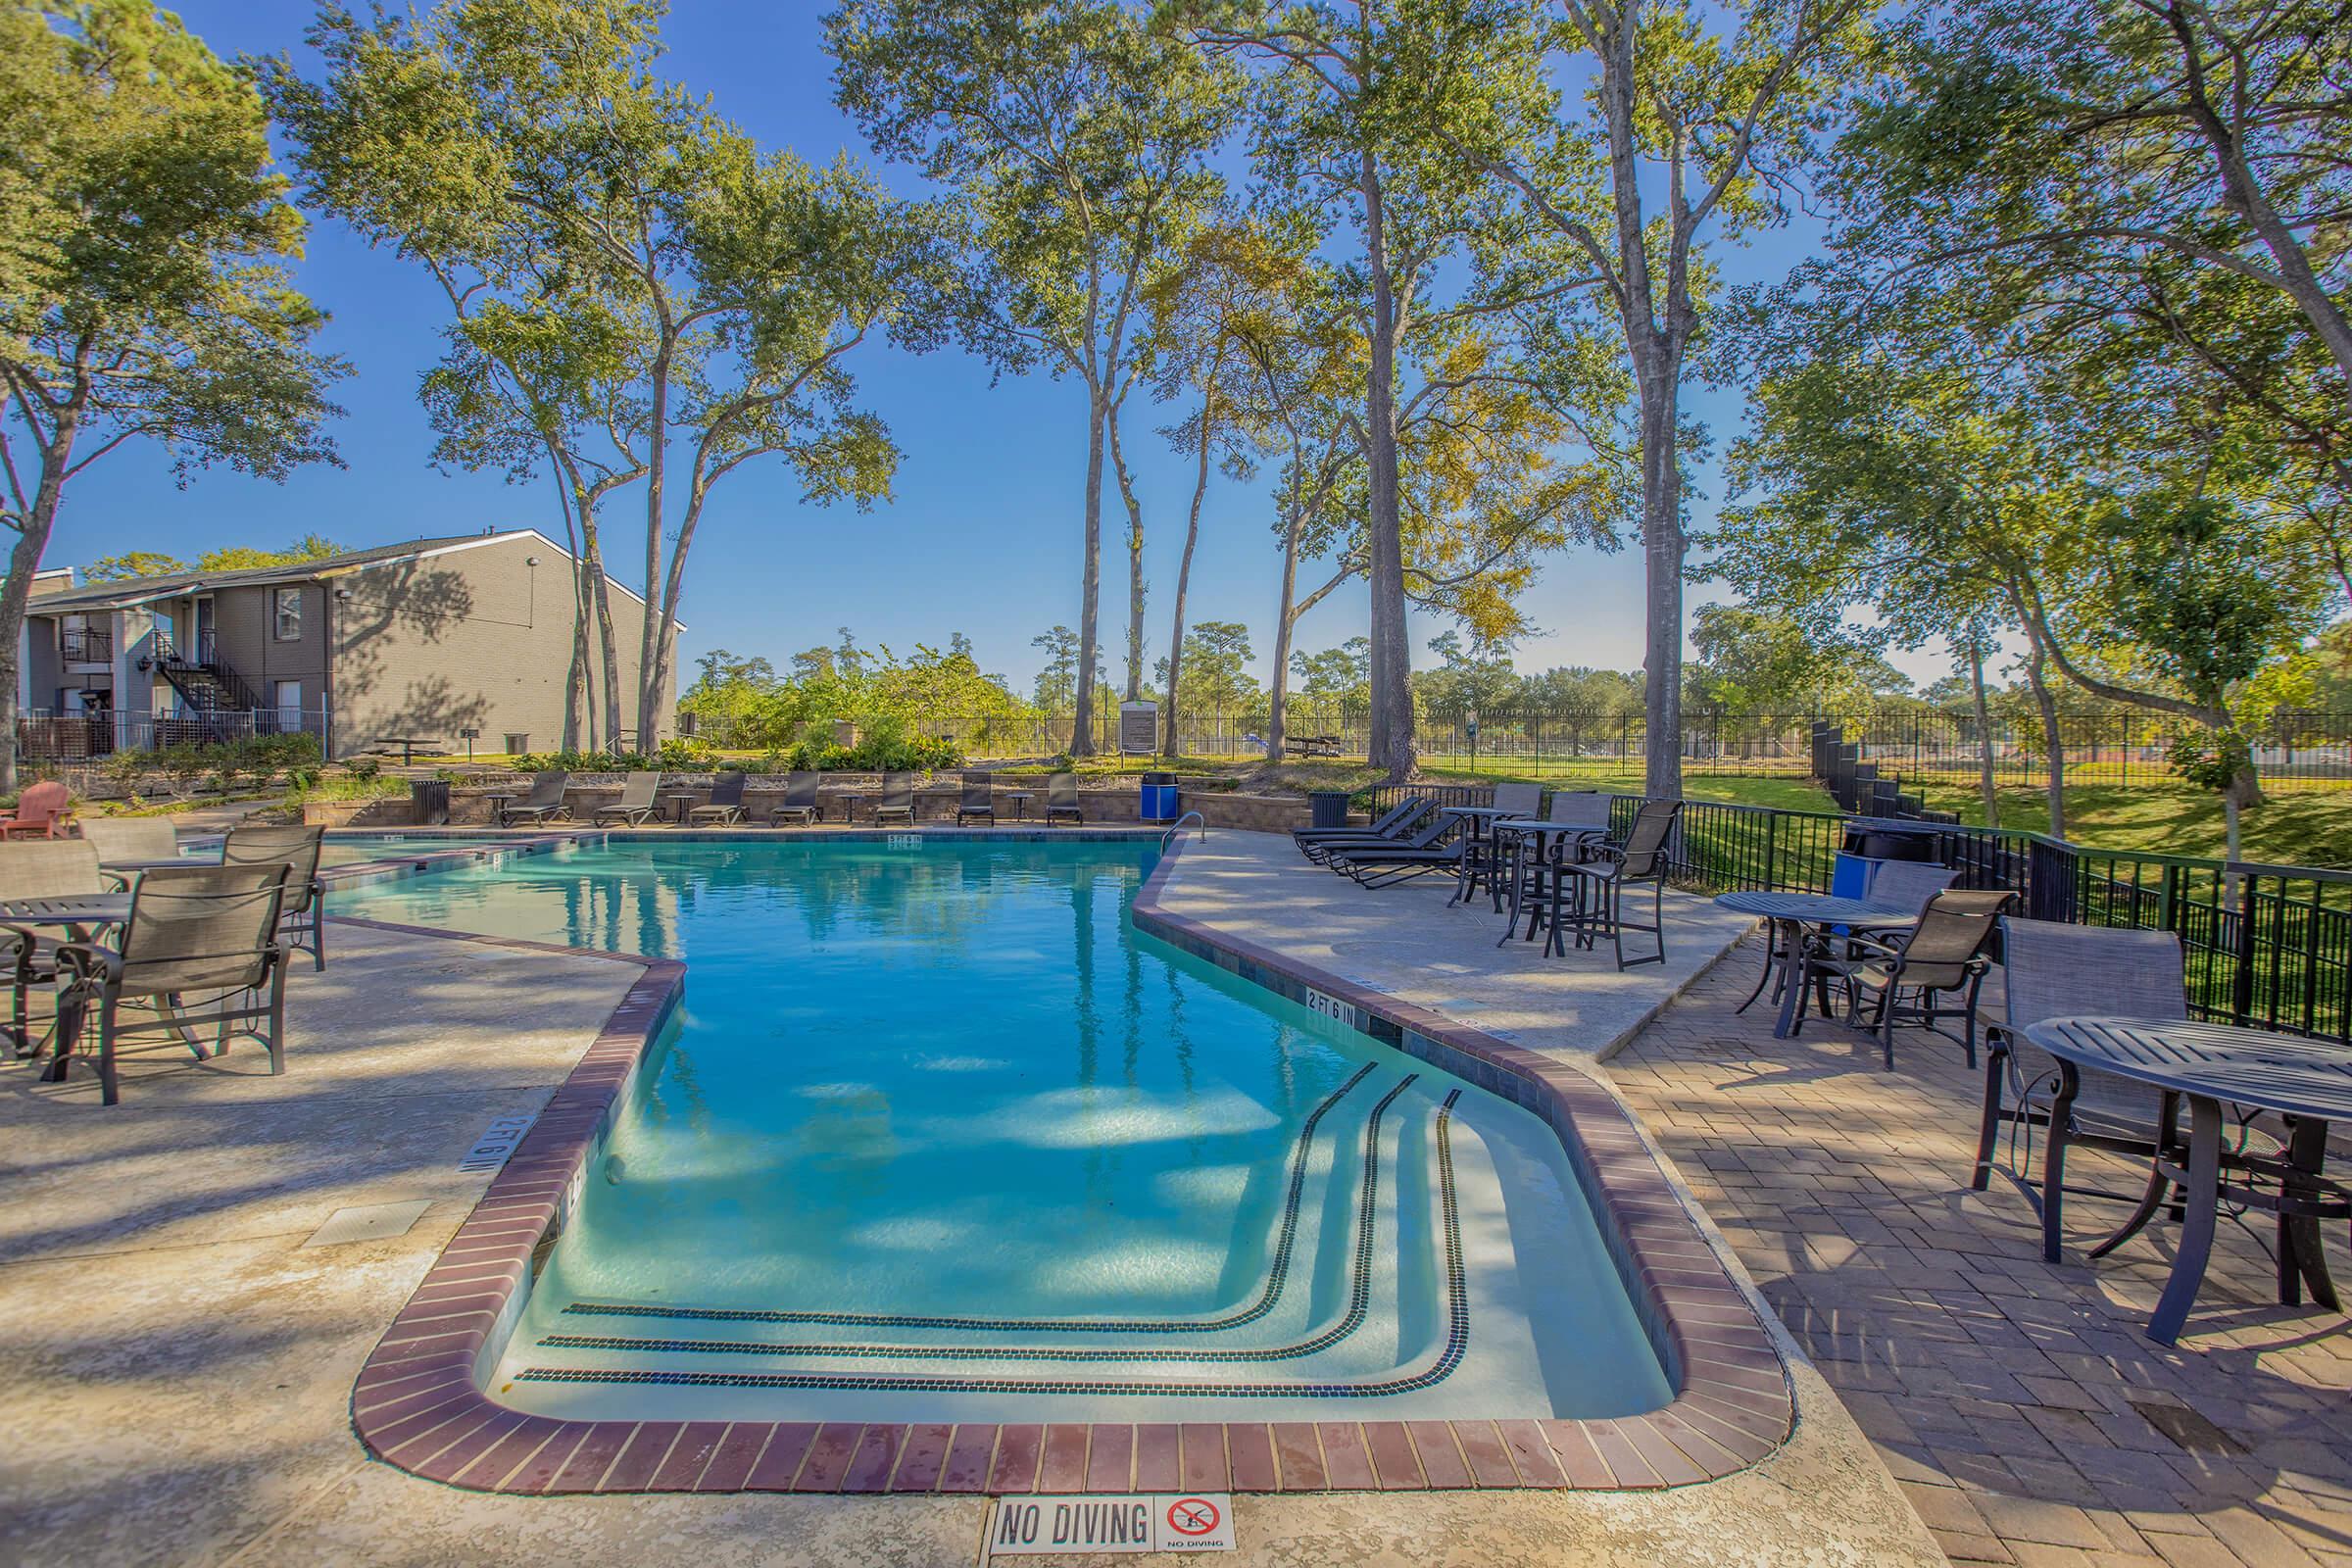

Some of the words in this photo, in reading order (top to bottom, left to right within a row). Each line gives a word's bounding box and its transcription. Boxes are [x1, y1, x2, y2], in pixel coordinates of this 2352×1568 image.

[1308, 991, 1315, 1009] 2
[1318, 995, 1330, 1015] FT
[1333, 1001, 1340, 1019] 6
[1343, 1004, 1353, 1027] IN
[495, 1119, 527, 1128] 2
[483, 1128, 521, 1142] FT
[473, 1145, 509, 1154] 6
[459, 1157, 503, 1173] IN
[998, 1503, 1041, 1545] NO
[1052, 1502, 1148, 1545] DIVING
